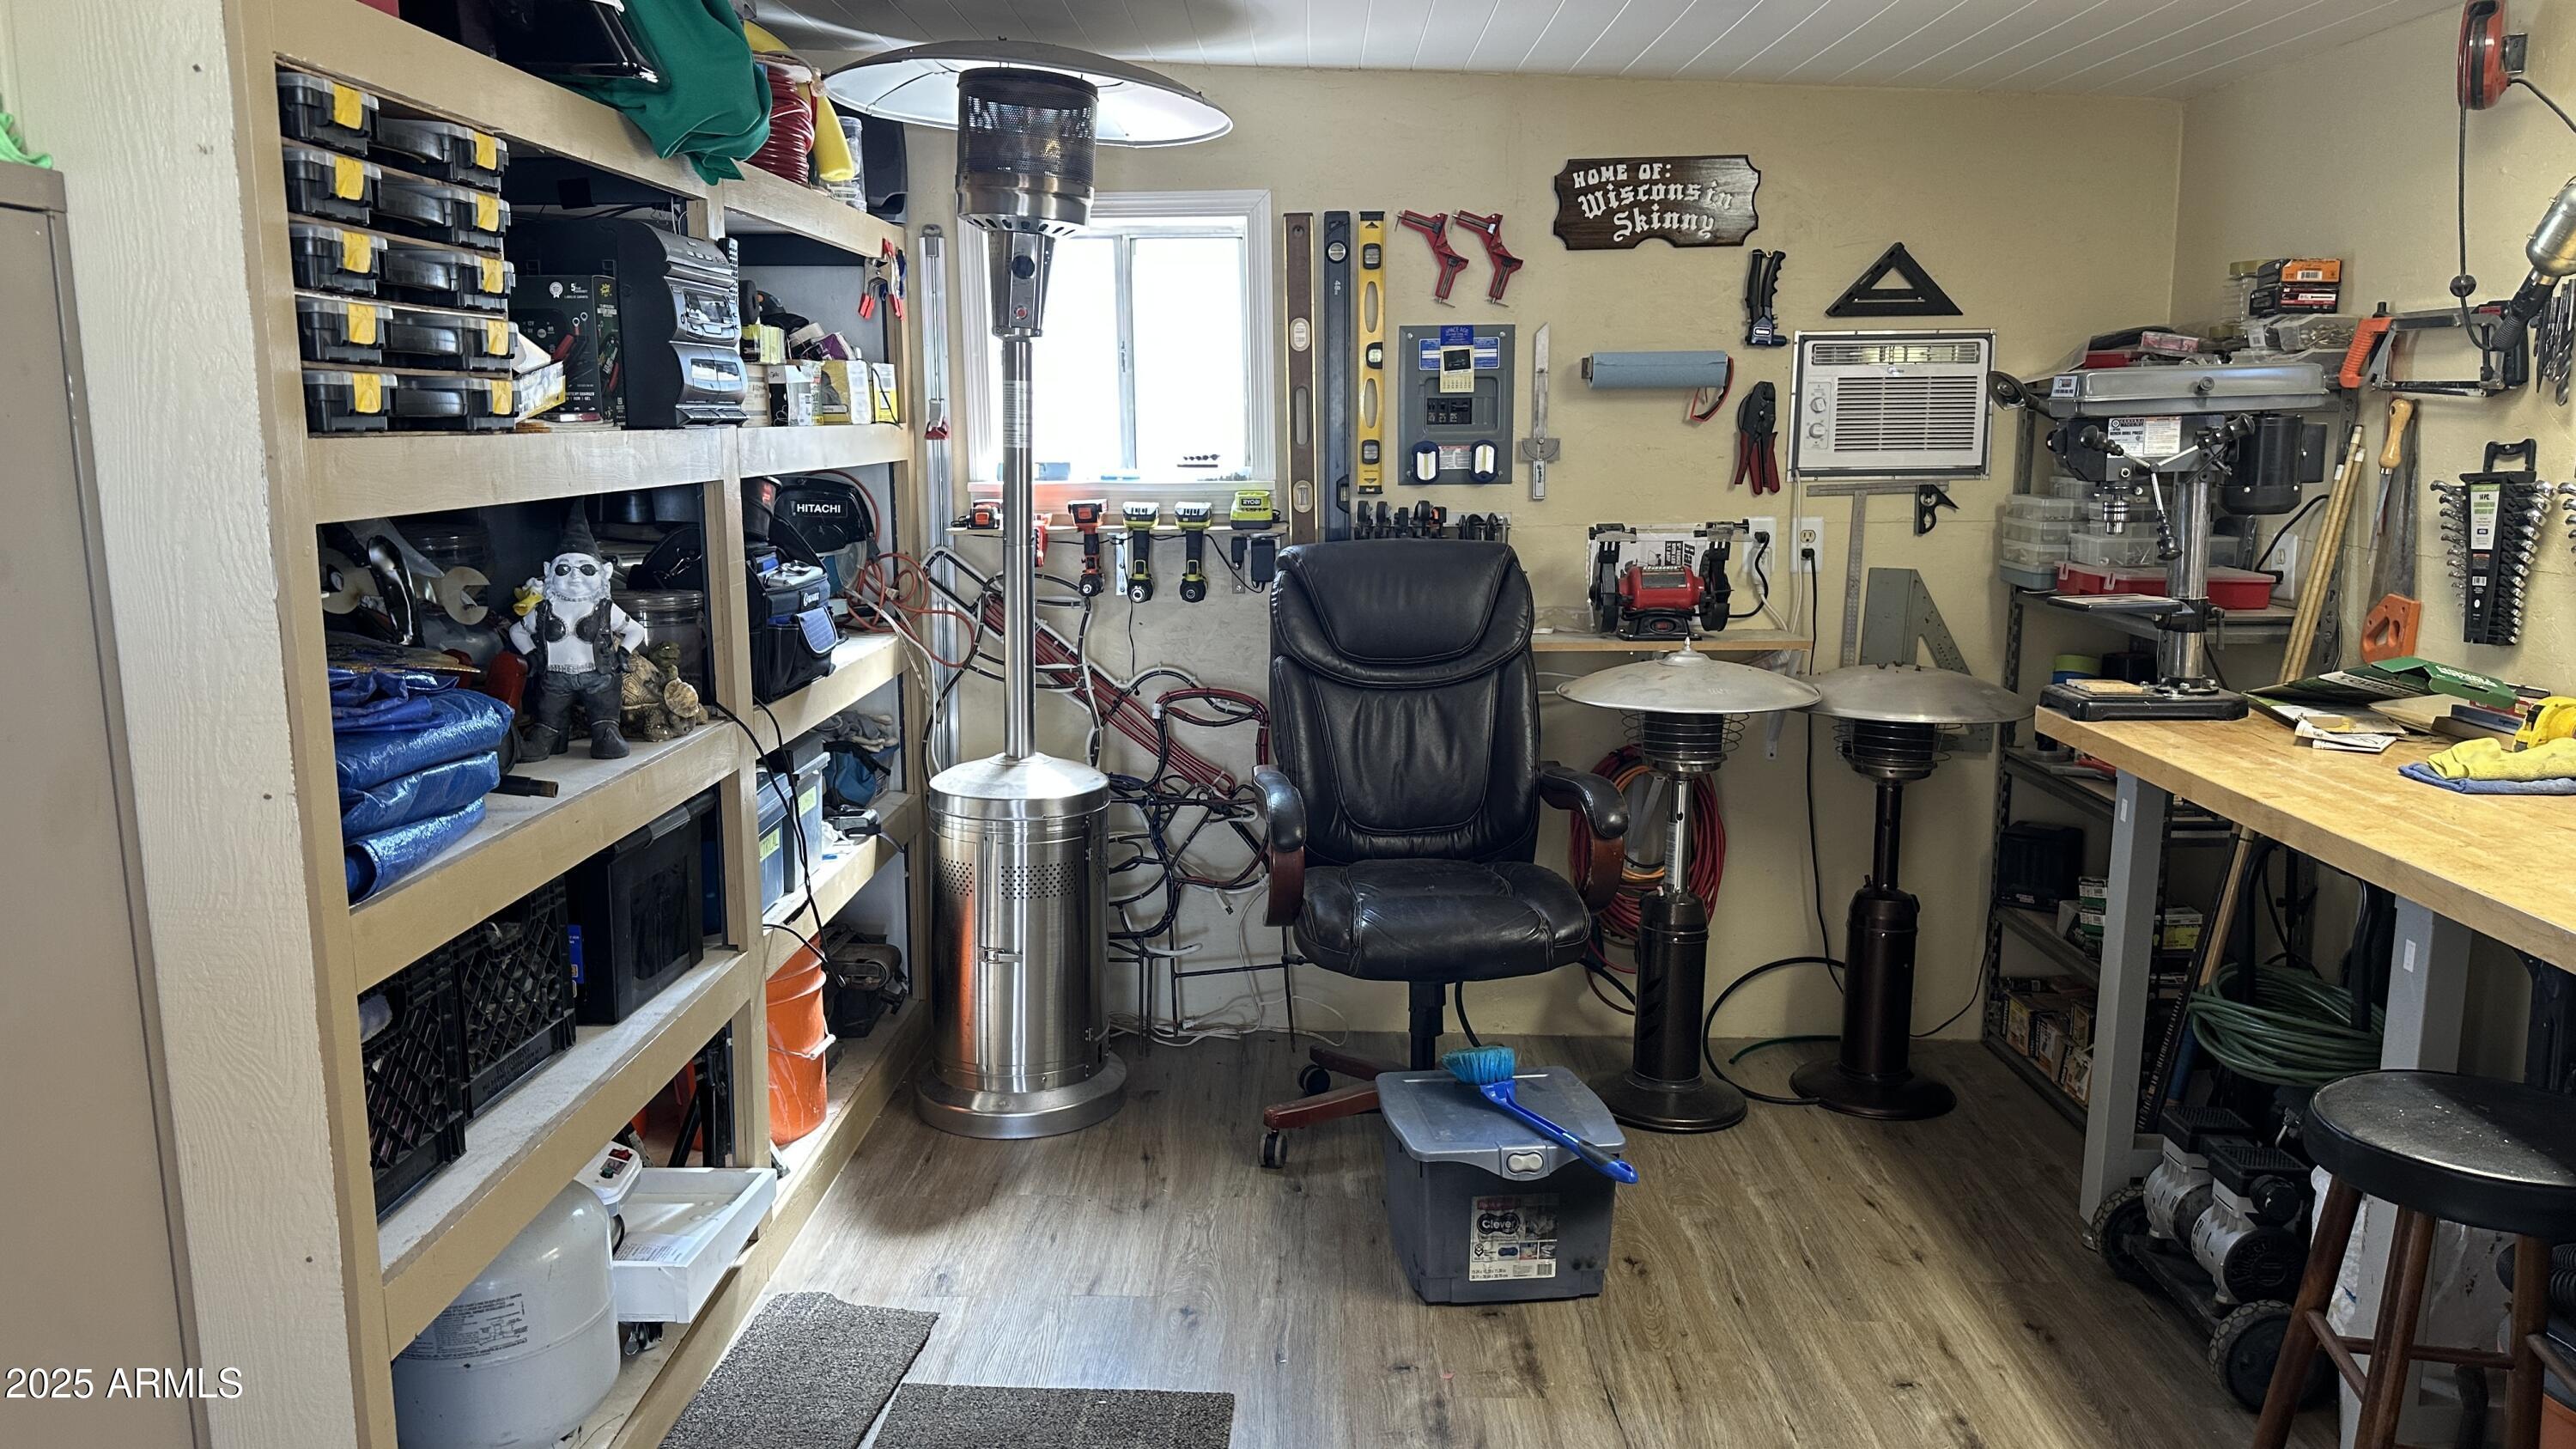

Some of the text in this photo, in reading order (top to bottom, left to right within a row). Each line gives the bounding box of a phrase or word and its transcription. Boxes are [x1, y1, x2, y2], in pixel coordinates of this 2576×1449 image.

[1572, 163, 1671, 188] HOME OF:
[1577, 179, 1734, 220] Wisconsin
[1613, 203, 1715, 242] Skinny
[796, 503, 841, 514] HITACHI
